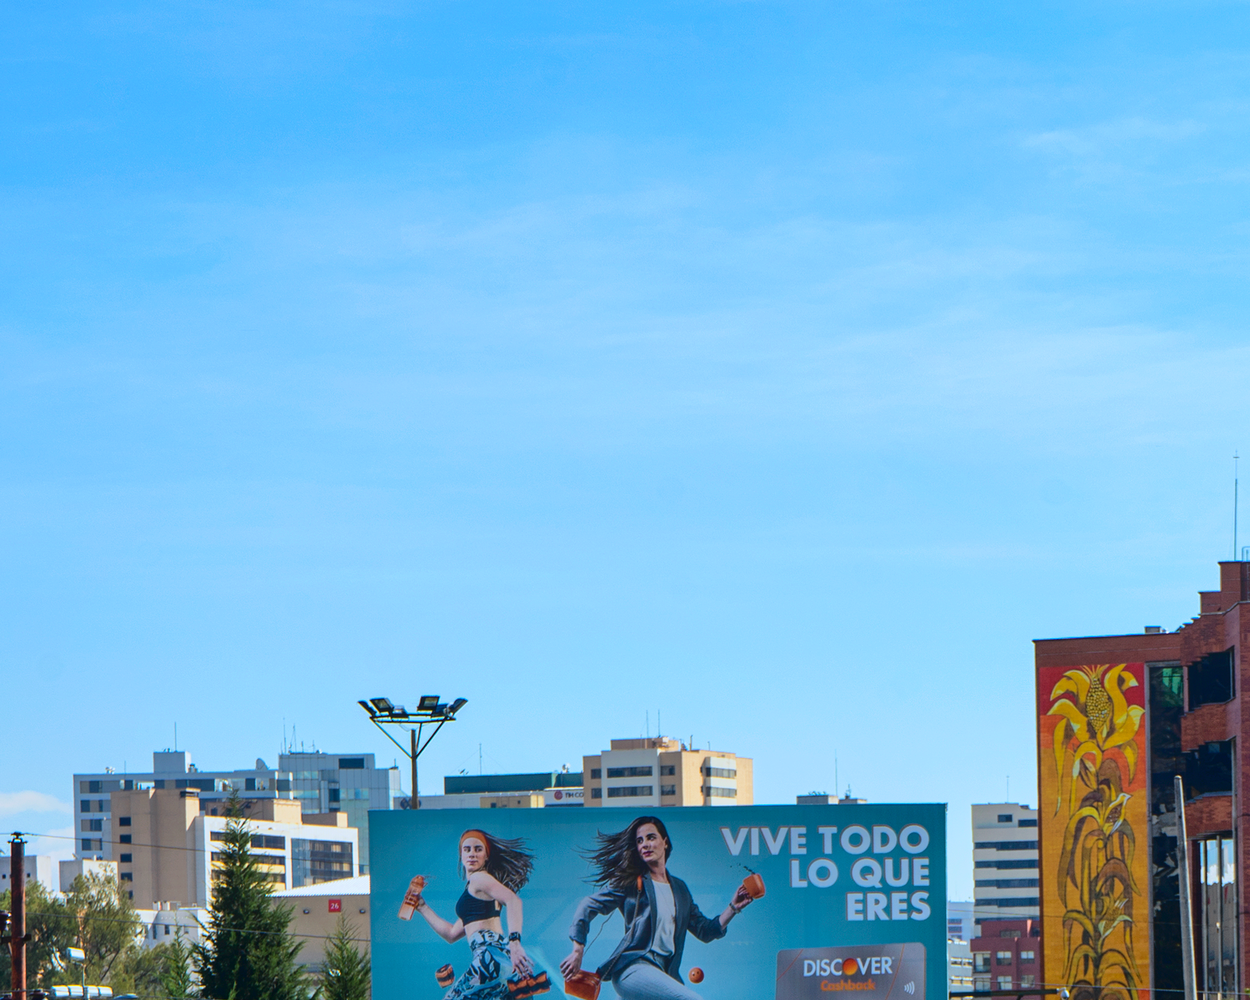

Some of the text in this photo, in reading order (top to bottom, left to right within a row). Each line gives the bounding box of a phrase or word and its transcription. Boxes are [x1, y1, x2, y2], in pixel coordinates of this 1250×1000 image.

[720, 824, 930, 856] VIVE TODO
[790, 857, 930, 888] LO QUE
[846, 890, 931, 921] ERES
[803, 957, 894, 977] DISCOVER
[820, 979, 876, 992] Cashback
